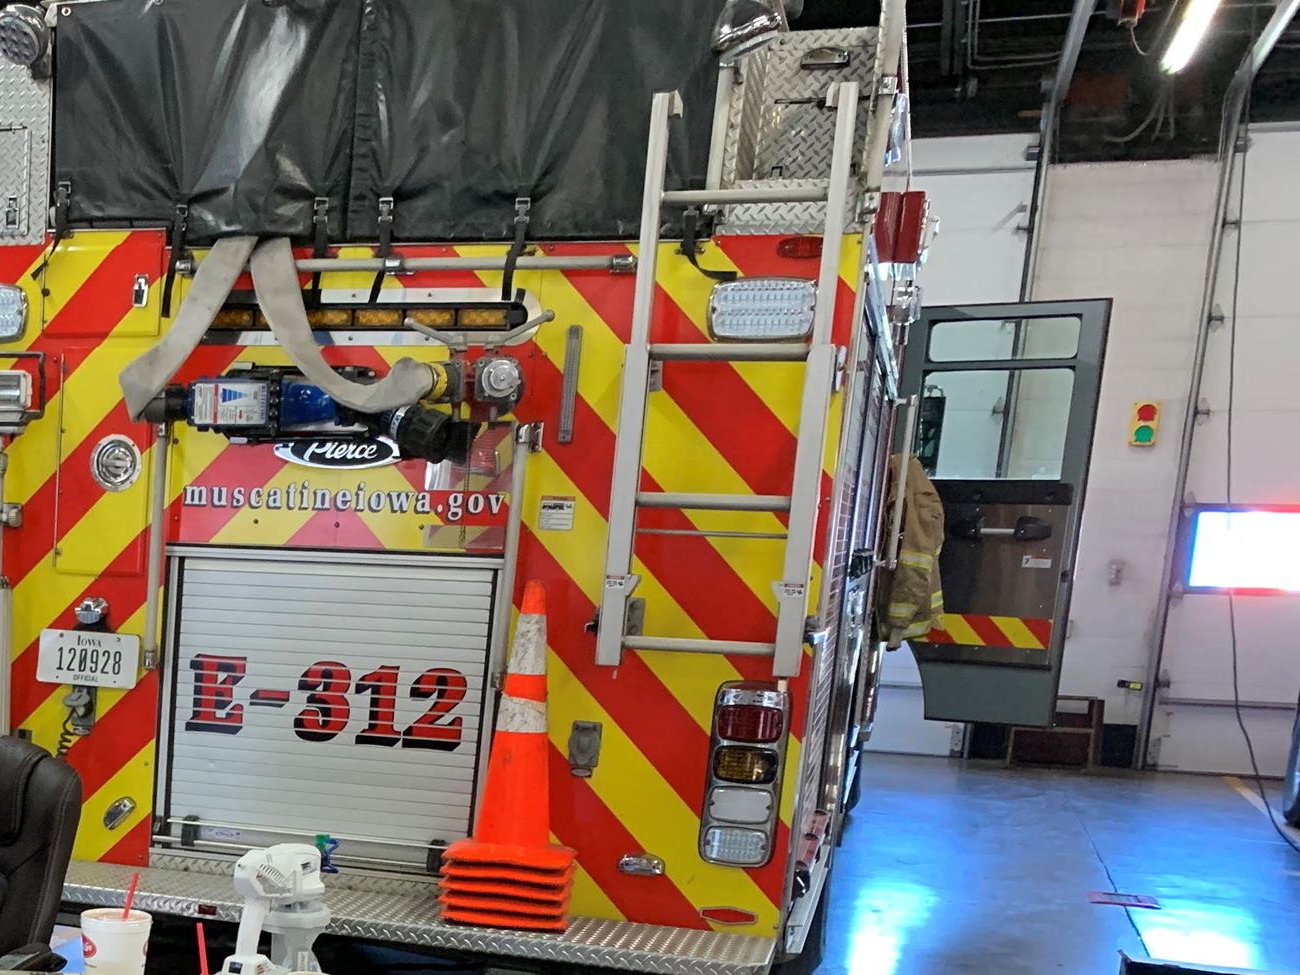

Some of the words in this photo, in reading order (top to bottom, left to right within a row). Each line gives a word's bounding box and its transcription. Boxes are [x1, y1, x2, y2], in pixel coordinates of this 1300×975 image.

[183, 480, 507, 523] muscatineiowa.gov
[56, 646, 122, 676] 120928
[73, 674, 99, 683] OFFICIAL
[184, 653, 468, 751] E-312
